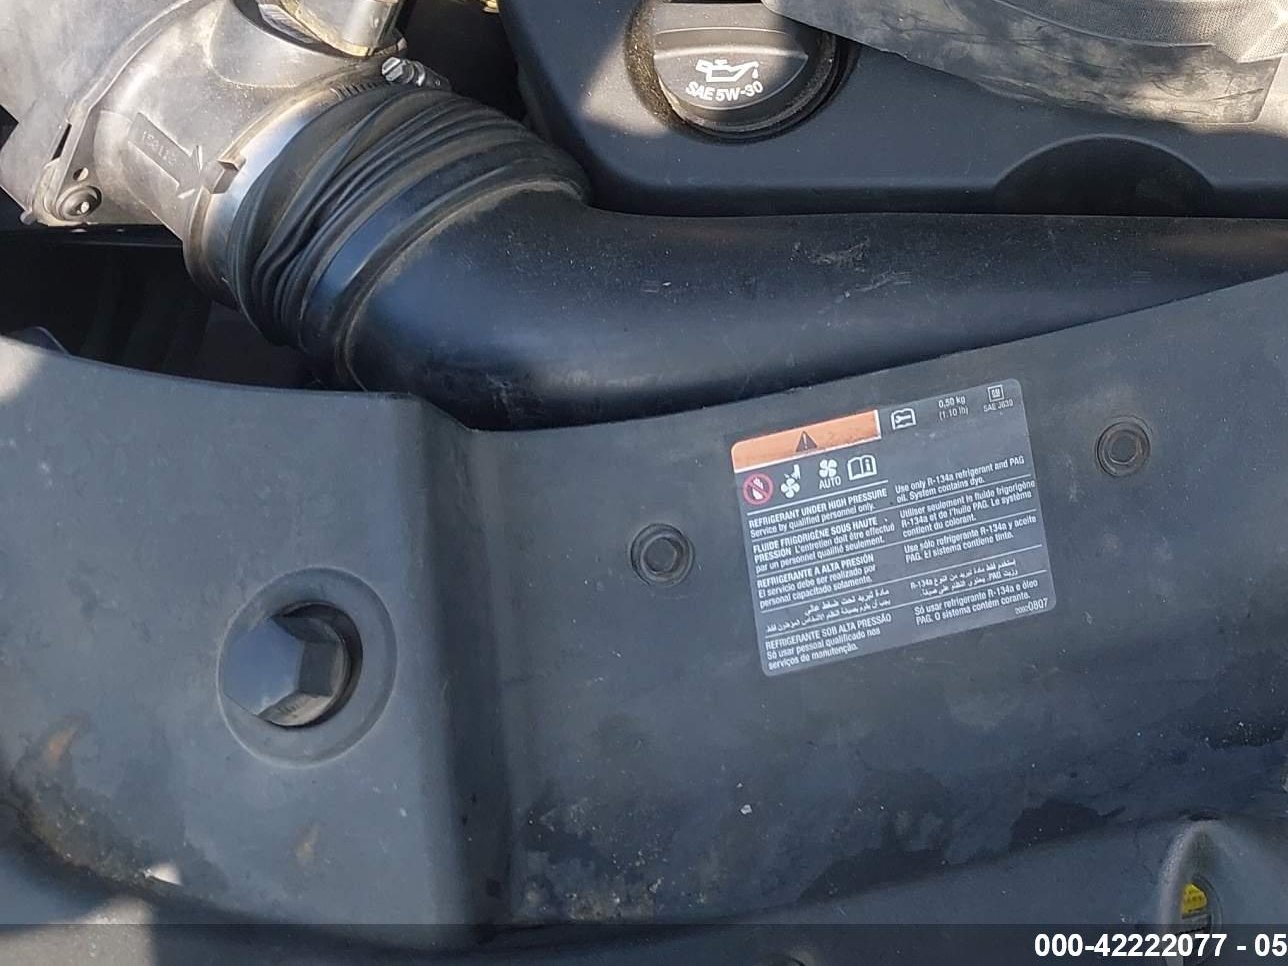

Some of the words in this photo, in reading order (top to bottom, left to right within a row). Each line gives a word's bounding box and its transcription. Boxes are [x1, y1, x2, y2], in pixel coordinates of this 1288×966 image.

[686, 80, 715, 101] SAE
[715, 80, 763, 101] 5W-30
[984, 403, 996, 412] SAE
[820, 477, 841, 489] AUTO
[895, 485, 909, 493] Use
[911, 480, 925, 490] only
[927, 474, 953, 485] R-134a
[956, 464, 992, 478] refrigerant
[995, 460, 1008, 470] and
[1010, 456, 1024, 466] PAG
[897, 494, 908, 503] oil.
[910, 488, 936, 500] System
[938, 481, 968, 492] contains
[970, 477, 984, 485] dye.
[750, 510, 798, 527] REFRIGERANT
[801, 503, 826, 515] UNDER
[828, 498, 846, 509] HIGH
[848, 489, 886, 504] PRESSURE
[900, 507, 925, 518] Utiliser
[927, 497, 964, 511] seulement
[975, 490, 994, 500] fluide
[997, 481, 1035, 495] frigorigène
[902, 516, 928, 527] R-134a
[949, 505, 971, 516] l'huile
[973, 500, 989, 510] PAG.
[1002, 492, 1031, 504] système
[751, 526, 777, 537] Service
[789, 515, 819, 529] qualified
[822, 507, 856, 522] personnel
[858, 503, 875, 512] only.
[754, 541, 778, 553] FLUIDE
[781, 529, 829, 546] FRIGORIGÈNE
[831, 523, 851, 535] SOUS
[853, 517, 877, 529] HAUTE
[903, 524, 932, 537] contient
[945, 514, 976, 527] colorant.
[904, 545, 918, 553] Use
[920, 540, 935, 550] sólo
[937, 530, 978, 545] refrigerante
[980, 523, 1006, 535] R-134a
[1015, 516, 1036, 527] aceite
[755, 548, 791, 562] PRESSION
[795, 539, 832, 553] L'entretien
[834, 534, 848, 544] doit
[849, 532, 864, 540] être
[866, 524, 894, 536] effectué
[756, 564, 767, 573] par
[781, 552, 815, 567] personnel
[817, 546, 843, 558] qualifié
[846, 537, 884, 551] seulement.
[906, 552, 922, 562] PAG.
[933, 544, 961, 556] sistema
[963, 537, 993, 549] contiene
[758, 569, 812, 587] REFRIGERANTE
[822, 562, 840, 573] ALTA
[841, 554, 873, 568] PRESIÓN
[768, 584, 795, 596] servicio
[797, 579, 815, 589] debe
[816, 576, 827, 584] ser
[830, 568, 862, 581] realizado
[864, 564, 875, 574] por
[760, 594, 791, 608] personal
[793, 585, 831, 599] capacitado
[834, 576, 871, 590] solamente.
[916, 614, 933, 625] PAG.
[943, 607, 970, 618] sistema
[972, 600, 999, 611] contém
[1001, 592, 1030, 604] corante.
[926, 603, 942, 612] usar
[944, 593, 986, 607] refrigerante
[988, 585, 1014, 597] R-134a
[1022, 580, 1038, 589] óleo
[766, 631, 819, 649] REFRIGERANTE
[822, 626, 837, 637] SOB
[839, 622, 856, 633] ALTA
[857, 614, 891, 627] PRESSÃO
[778, 648, 794, 657] usar
[796, 640, 824, 654] pessoal
[826, 631, 865, 646] qualificado
[867, 628, 880, 636] nos
[769, 657, 799, 669] serviços
[812, 644, 857, 659] manutenção.
